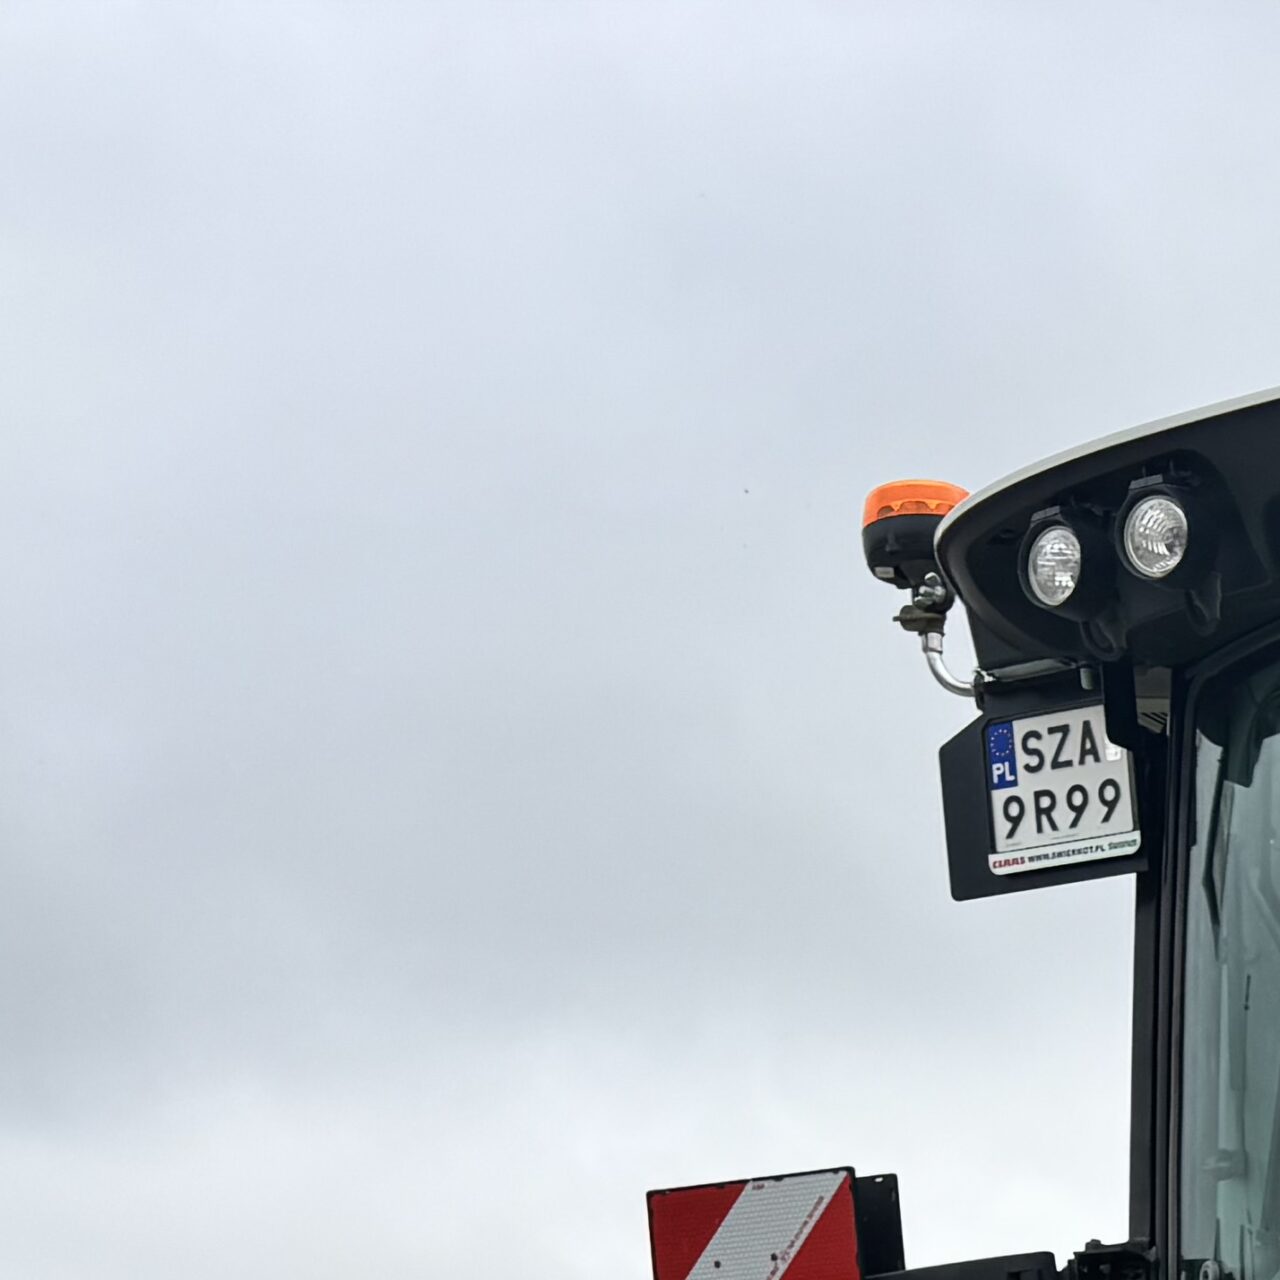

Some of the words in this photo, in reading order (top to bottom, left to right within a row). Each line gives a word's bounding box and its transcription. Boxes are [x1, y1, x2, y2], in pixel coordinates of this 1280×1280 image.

[991, 761, 1016, 784] PL
[1021, 719, 1101, 774] SZA
[1002, 777, 1121, 840] 9R99
